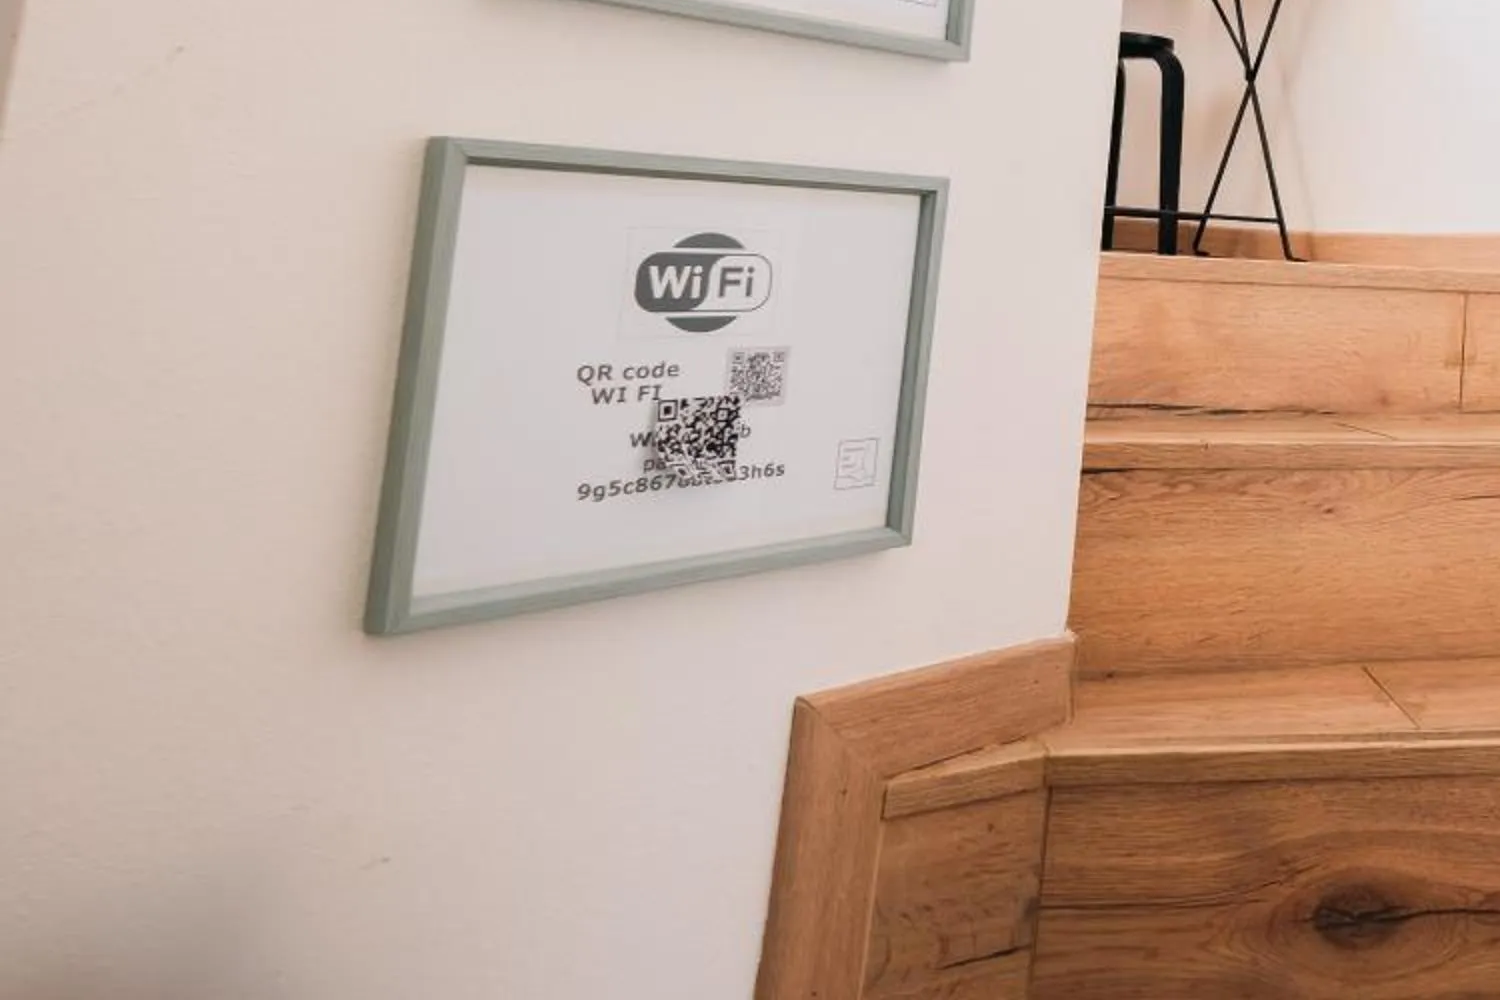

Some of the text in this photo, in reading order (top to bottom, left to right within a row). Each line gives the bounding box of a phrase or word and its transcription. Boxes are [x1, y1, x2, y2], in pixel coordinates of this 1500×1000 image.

[576, 360, 681, 387] QR code
[590, 385, 663, 405] WI FI
